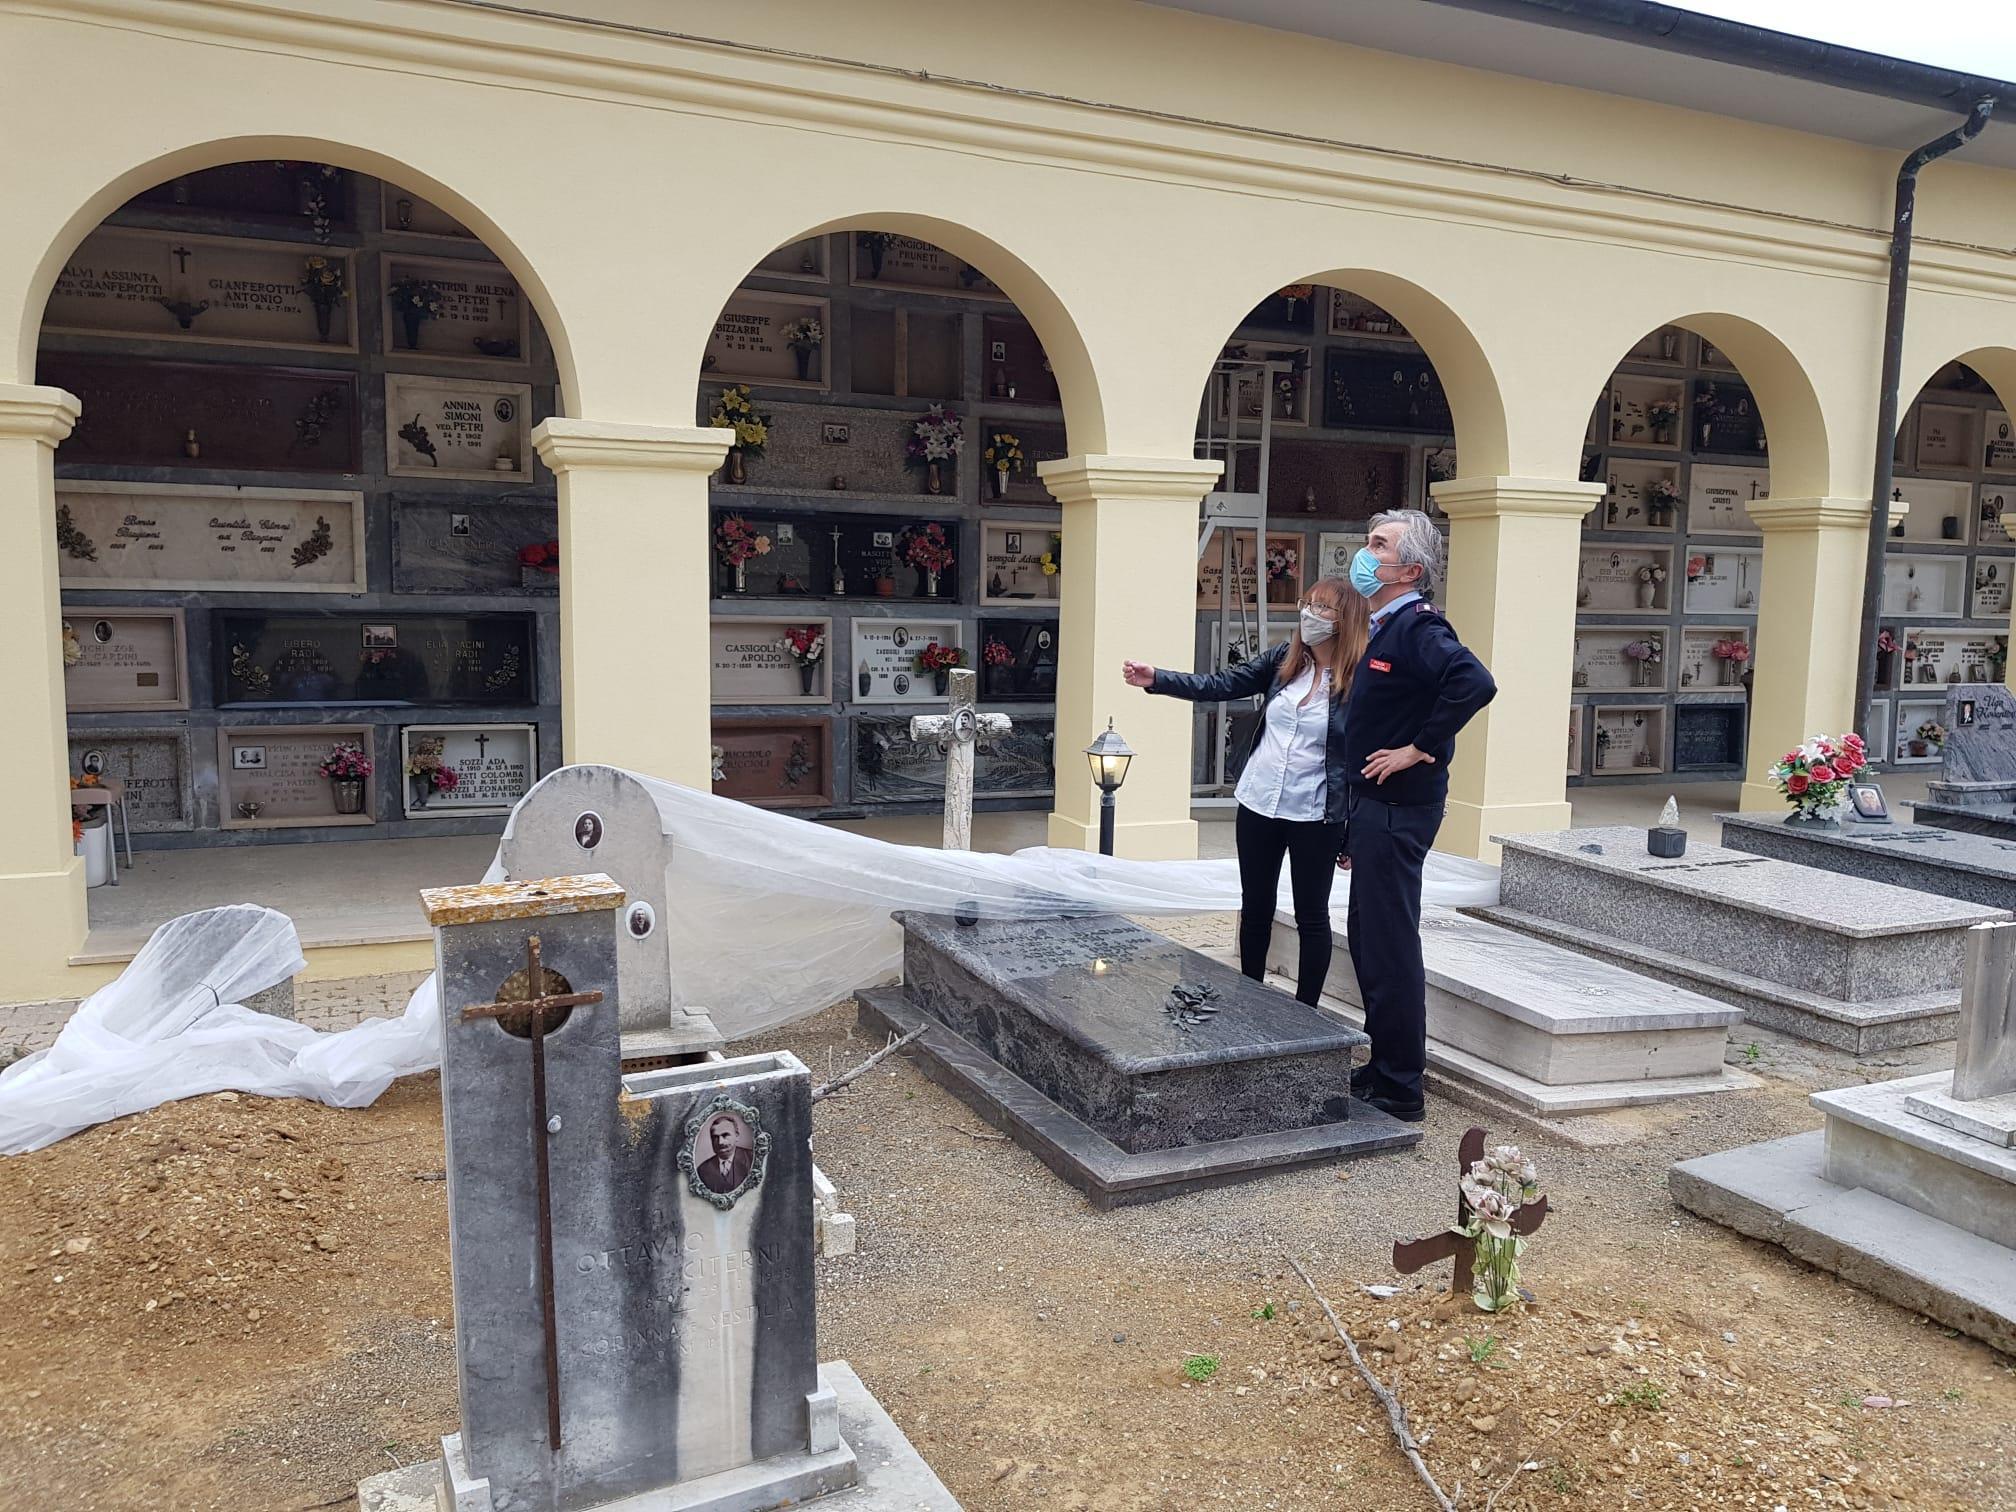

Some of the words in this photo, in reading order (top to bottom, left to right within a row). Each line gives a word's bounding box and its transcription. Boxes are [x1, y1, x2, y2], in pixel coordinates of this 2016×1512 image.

[103, 270, 160, 283] ASSUNTA
[80, 280, 162, 294] GIANFEROTTI
[209, 280, 296, 295] GIANFEROTTI
[475, 284, 515, 296] MILENA
[225, 292, 283, 304] ANTONIO
[458, 295, 490, 305] PETRI
[723, 313, 771, 326] GIUSEPPE
[716, 323, 761, 335] BIZZARRI
[442, 400, 482, 412] ANNINA
[444, 411, 482, 422] SIMONI
[453, 421, 484, 432] PETRI
[283, 639, 321, 649] LIBERO
[725, 644, 777, 654] CASSIGOLI
[740, 653, 782, 663] AROLDO
[459, 759, 485, 767] SOZZI
[488, 758, 507, 766] ADA
[480, 771, 524, 781] COLOMBA
[474, 784, 521, 794] LEONARDO
[576, 1232, 704, 1273] OTTAVIO
[682, 1242, 780, 1281] CITERNI
[581, 1322, 680, 1358] CORINNA
[709, 1296, 794, 1331] SESTILIA
